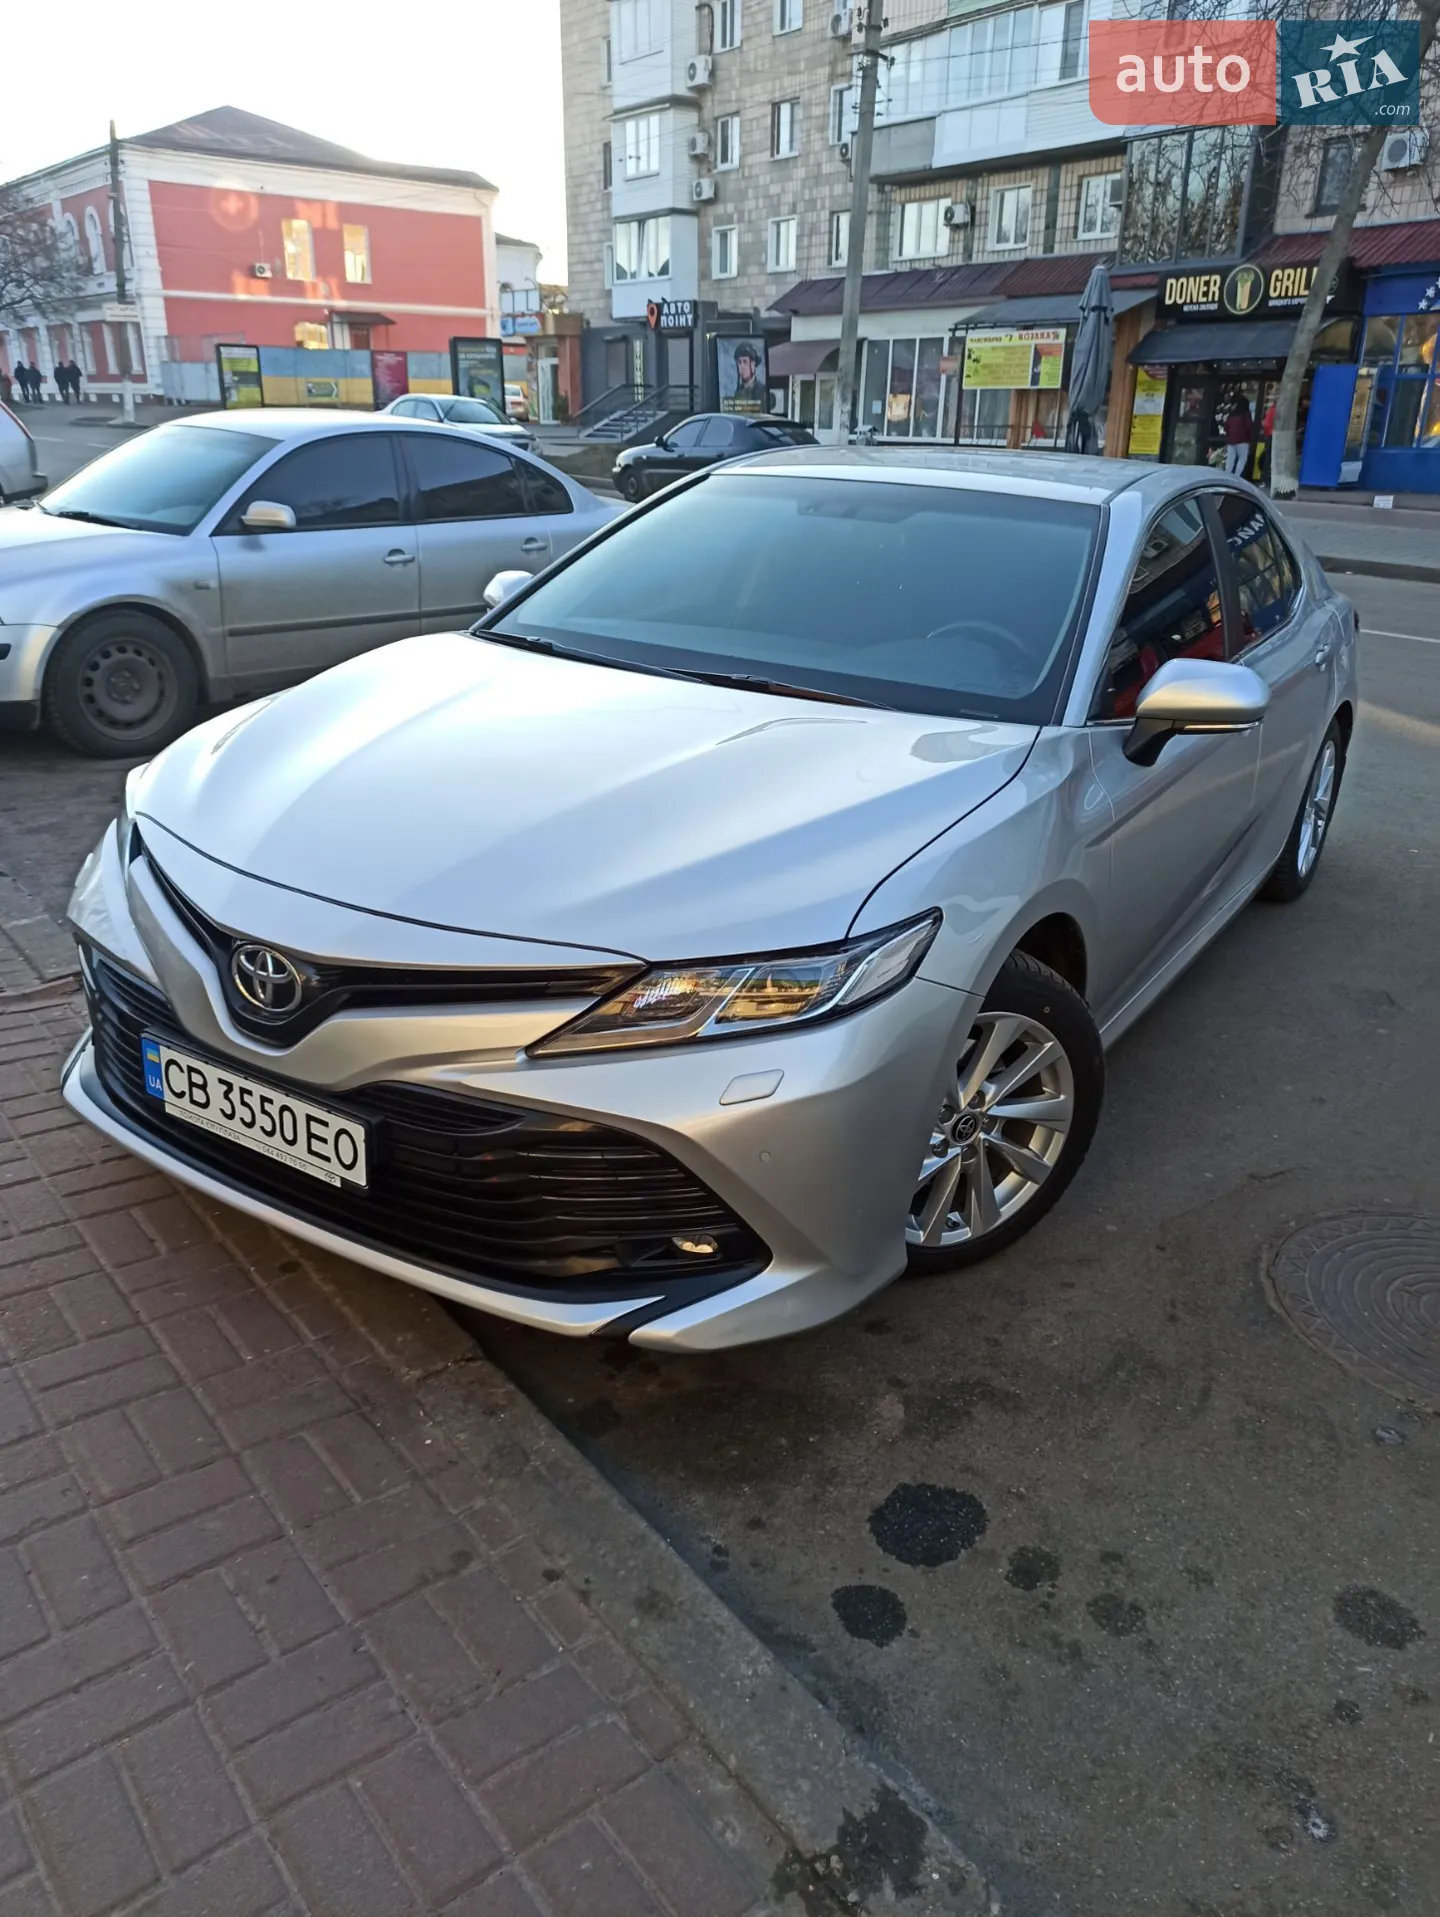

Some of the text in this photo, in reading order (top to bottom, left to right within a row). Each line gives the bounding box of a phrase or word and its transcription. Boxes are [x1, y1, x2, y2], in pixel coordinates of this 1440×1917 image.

[1164, 274, 1221, 306] DONER
[662, 301, 691, 315] АВТО
[660, 314, 694, 328] ПОІНТ
[149, 1074, 164, 1091] UA
[164, 1058, 359, 1171] CB 3550 EO
